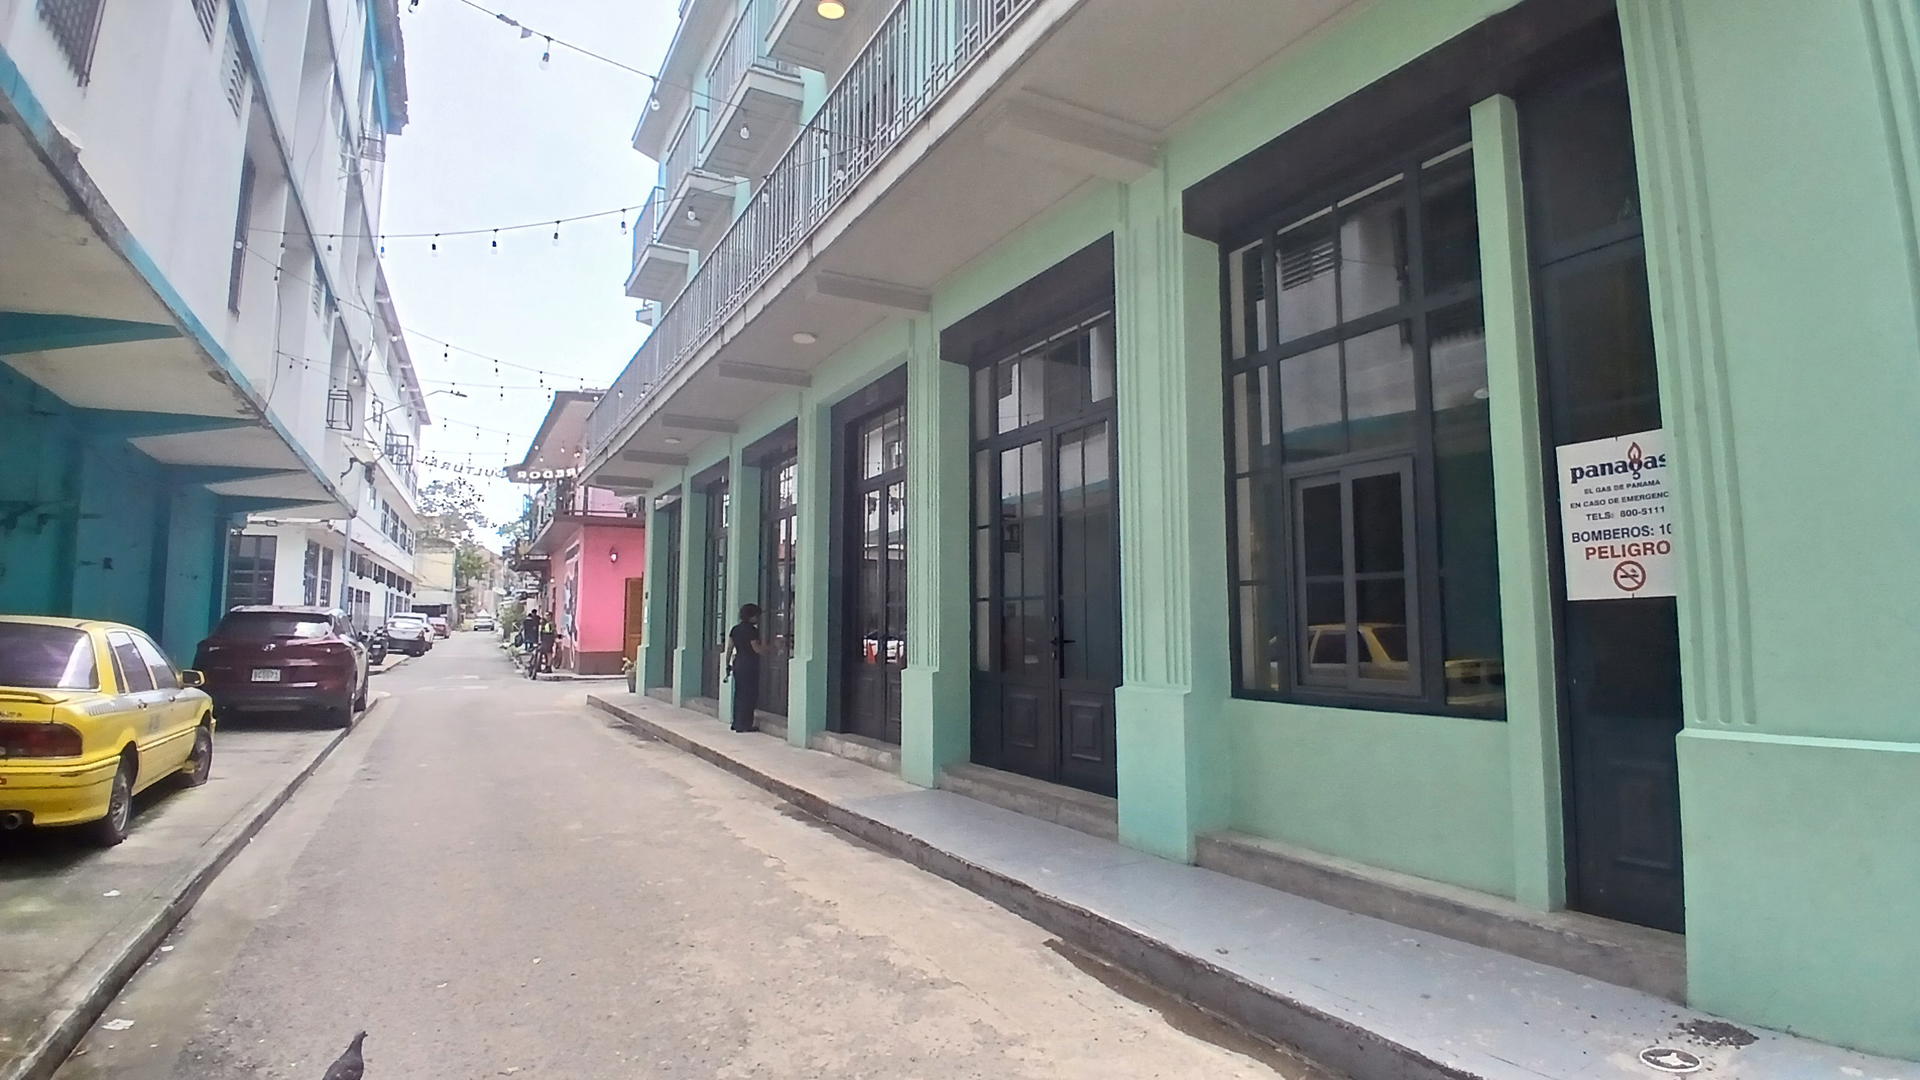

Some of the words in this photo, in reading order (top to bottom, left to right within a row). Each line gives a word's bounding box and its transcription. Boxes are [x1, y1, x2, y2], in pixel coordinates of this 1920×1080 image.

[1570, 453, 1666, 484] panagas
[1596, 485, 1612, 493] GAS
[1583, 499, 1605, 507] CASO
[1586, 512, 1614, 521] TELS:
[1620, 506, 1665, 518] 800-5111
[1572, 526, 1654, 543] BOMBEROS:
[1585, 541, 1670, 560] PELIGRO
